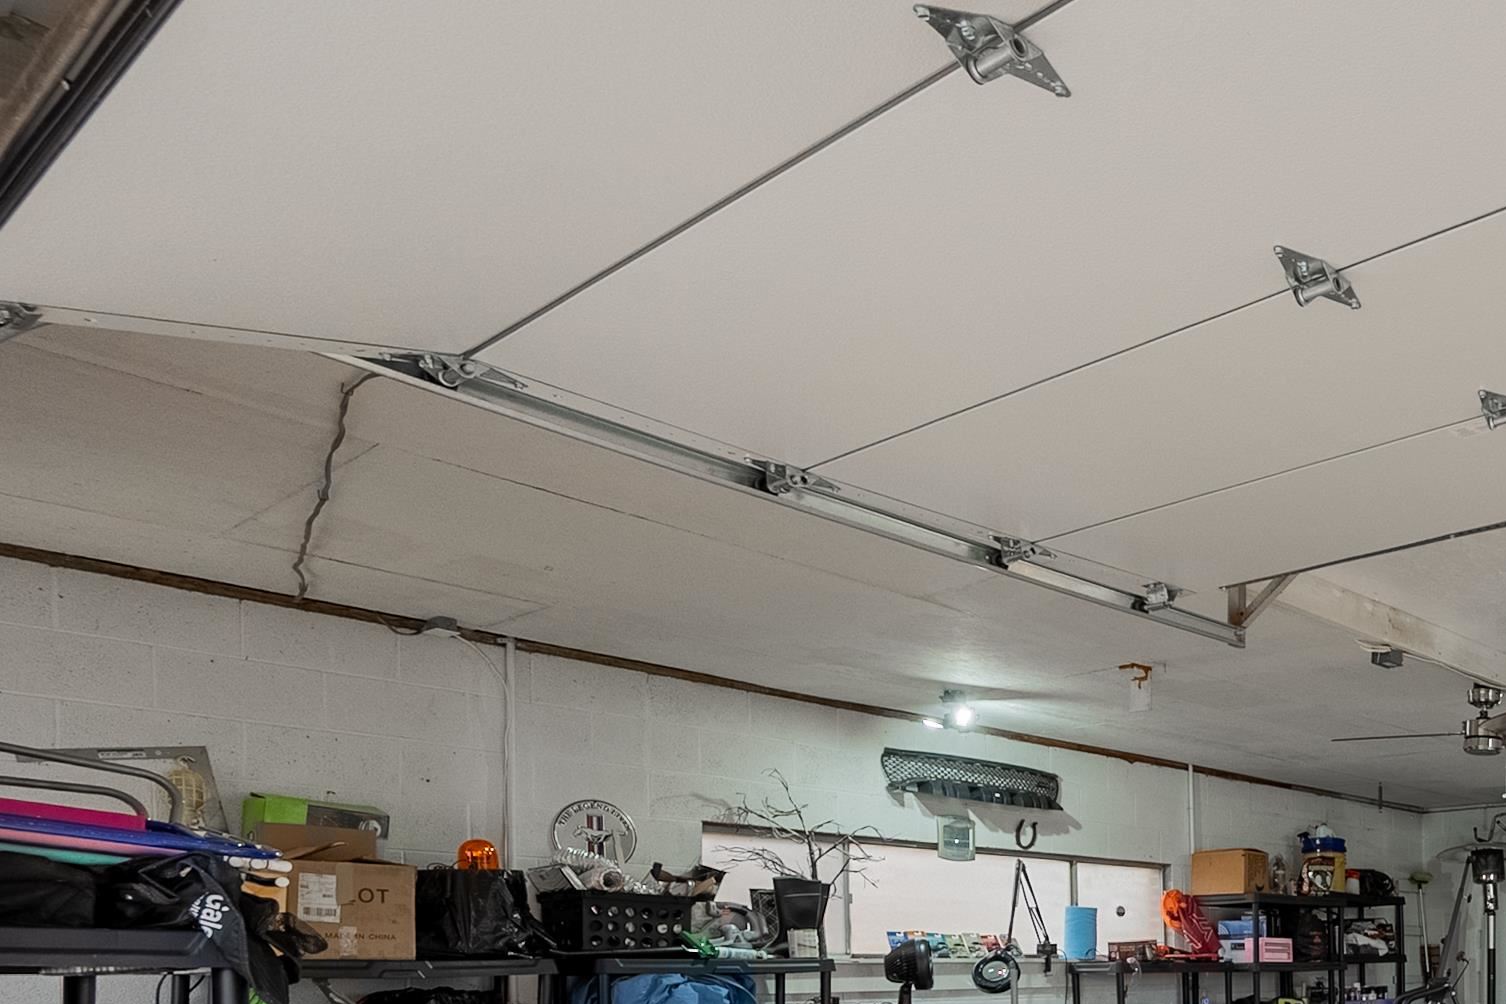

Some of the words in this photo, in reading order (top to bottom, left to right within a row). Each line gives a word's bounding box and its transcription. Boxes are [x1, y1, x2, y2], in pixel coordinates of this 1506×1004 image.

[558, 809, 572, 826] THE
[571, 801, 610, 814] LEGEND
[368, 933, 397, 941] CHINA
